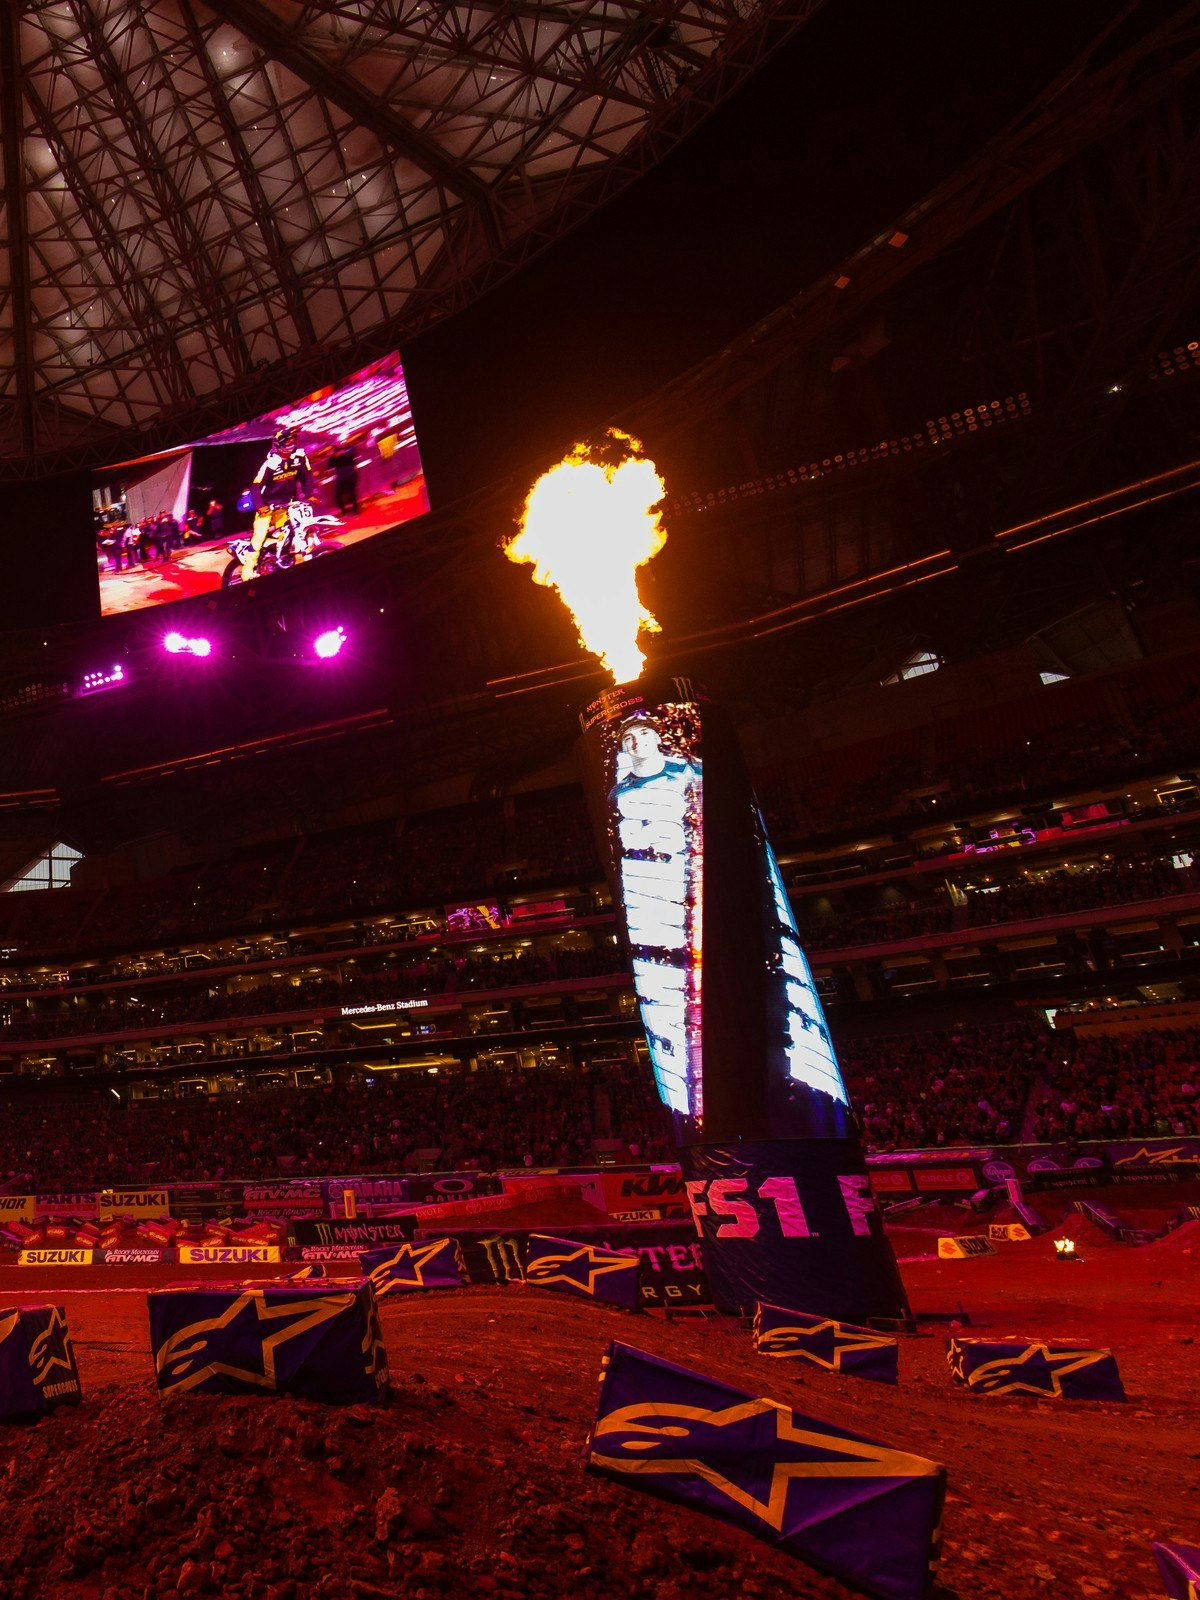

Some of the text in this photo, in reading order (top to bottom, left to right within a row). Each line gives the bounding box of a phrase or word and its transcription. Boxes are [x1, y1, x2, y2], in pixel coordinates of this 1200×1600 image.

[585, 695, 645, 730] SUPERCROSS
[340, 999, 429, 1016] Mercedes-Benz Stadium
[920, 1174, 954, 1183] CIRCLE
[35, 1193, 97, 1204] PARTS
[101, 1193, 166, 1207] SUZUKI
[416, 1206, 443, 1218] OYOTA
[334, 1223, 406, 1244] MONSTER
[27, 1250, 85, 1263] SUZUKI
[190, 1249, 268, 1261] SUZUKI
[41, 1379, 79, 1399] SUPERCROSS
